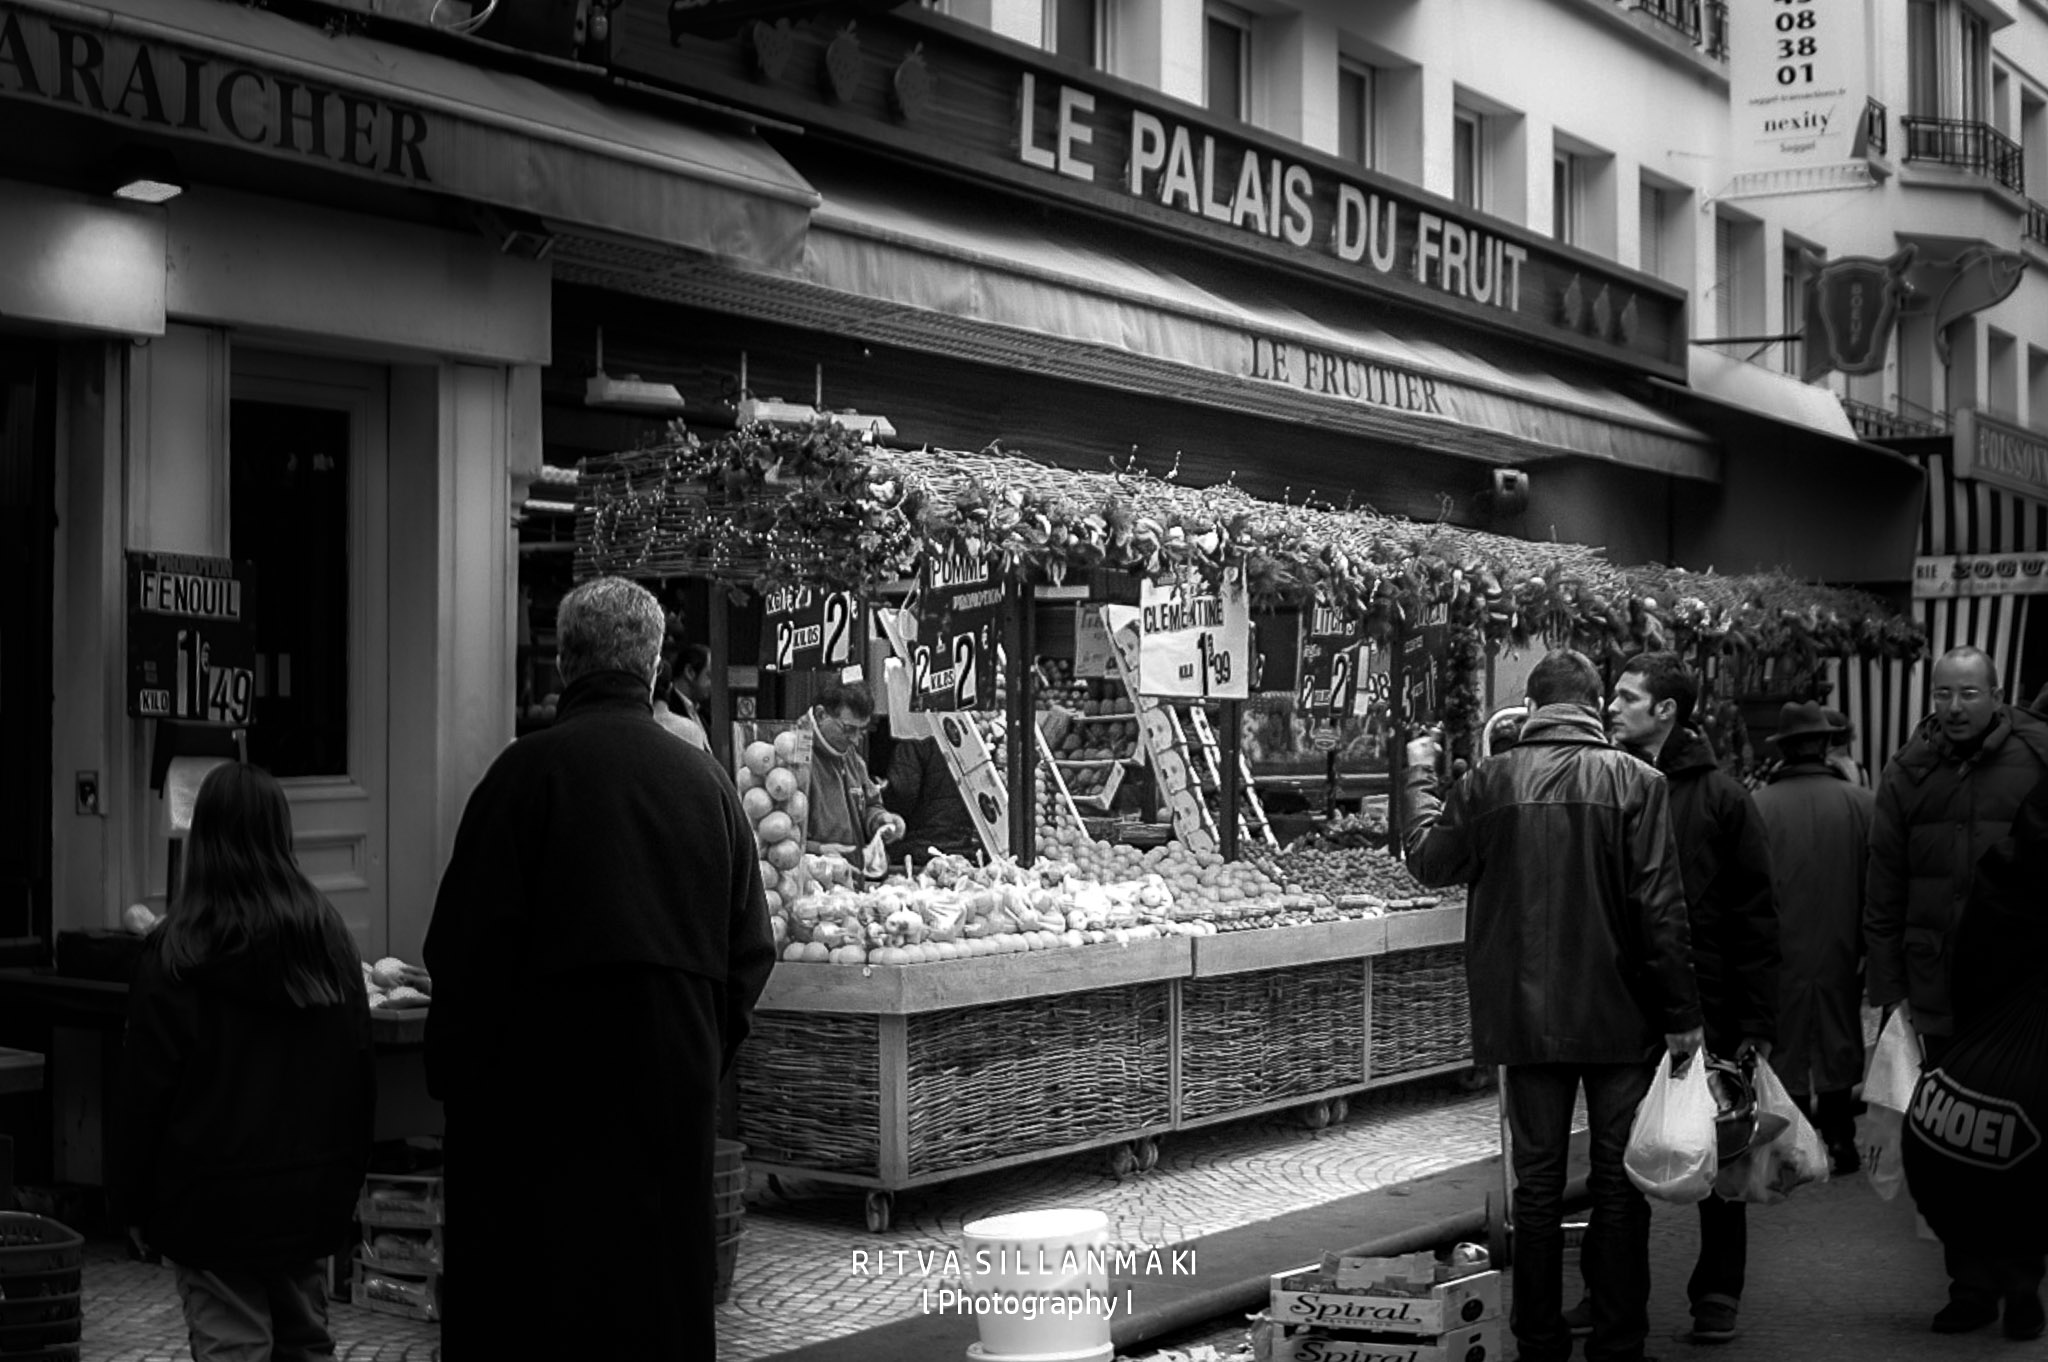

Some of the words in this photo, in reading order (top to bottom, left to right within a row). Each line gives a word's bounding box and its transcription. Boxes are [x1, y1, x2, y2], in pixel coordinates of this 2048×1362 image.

[1776, 10, 1816, 32] 08
[1778, 36, 1817, 59] 38
[1778, 62, 1814, 85] 01
[0, 13, 431, 182] ARAICHER
[1764, 105, 1836, 136] nexity
[1021, 72, 1095, 182] LE
[1131, 109, 1315, 247] PALAIS
[1338, 182, 1397, 273] DU
[1419, 211, 1528, 312] FRUIT
[1248, 335, 1290, 383] LE
[1304, 346, 1444, 415] FRUITIER
[142, 572, 239, 617] FENOUIL
[1143, 599, 1224, 633] CLEMENTINE
[778, 621, 793, 671] 2
[916, 646, 930, 695] 2
[142, 690, 170, 712] KILO
[1913, 1079, 2017, 1159] SHOEI
[1289, 1294, 1410, 1320] Spiral
